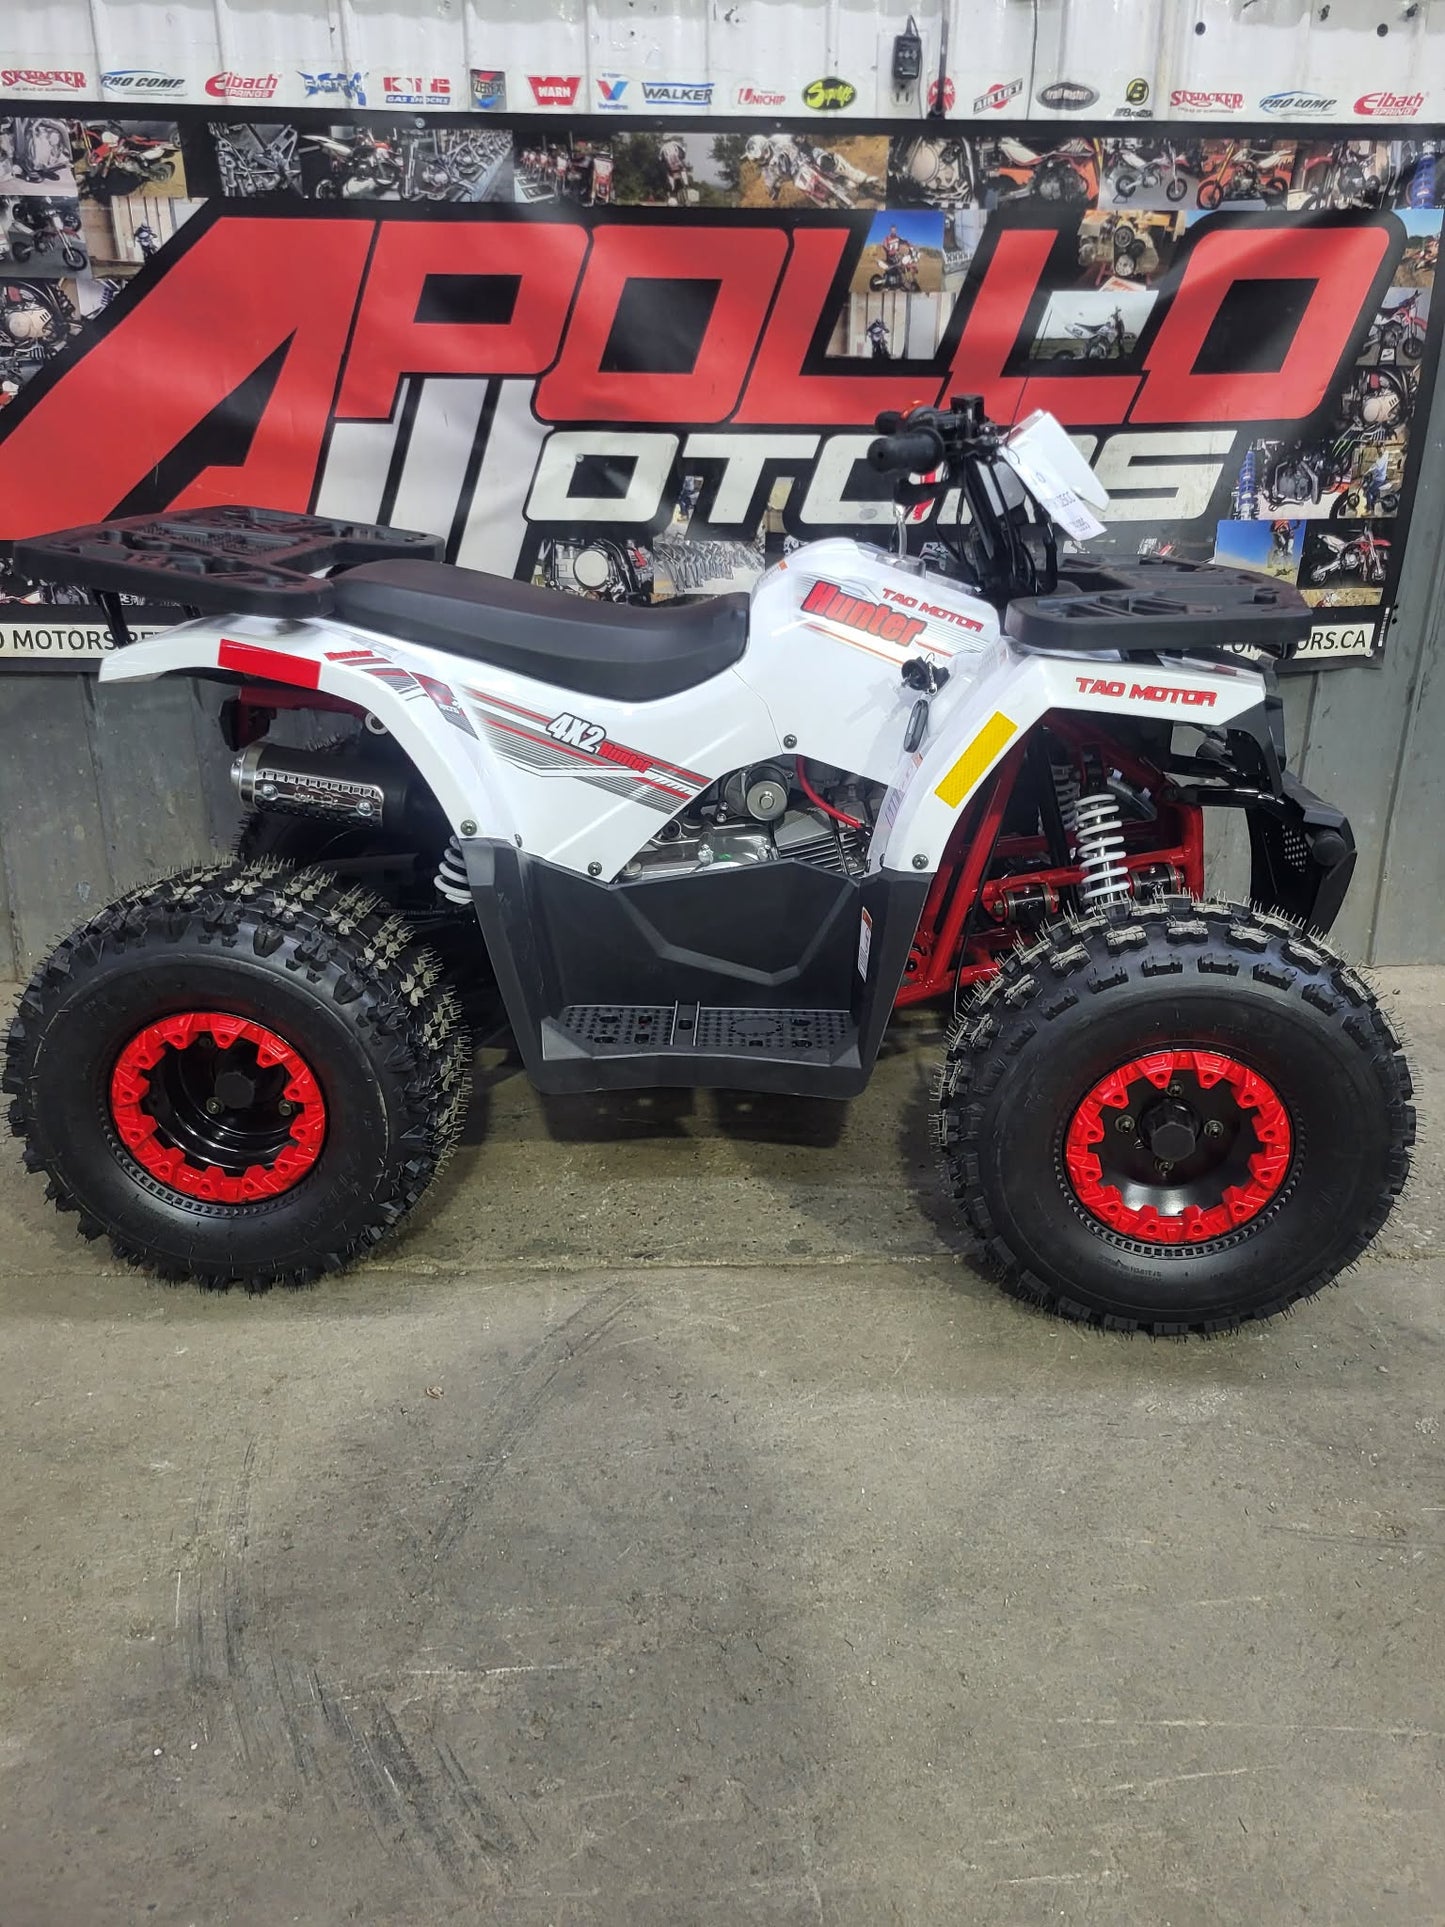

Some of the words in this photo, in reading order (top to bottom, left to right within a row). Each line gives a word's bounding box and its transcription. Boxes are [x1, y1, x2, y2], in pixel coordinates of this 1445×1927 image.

[101, 75, 132, 87] PRO
[135, 77, 186, 89] COMP
[205, 71, 279, 98] Eibach
[538, 86, 571, 98] WARN
[642, 83, 713, 105] WALKER
[1260, 98, 1294, 108] PRO
[1354, 92, 1425, 116] Eibach
[0, 216, 1392, 540] APOLLO
[800, 579, 927, 647] Hunter
[883, 587, 918, 608] TAO
[918, 602, 984, 633] MOTOR
[13, 630, 118, 650] MOTORS
[1076, 677, 1126, 697] TAO
[1128, 685, 1217, 707] MOTOR
[546, 712, 607, 754] 4X2
